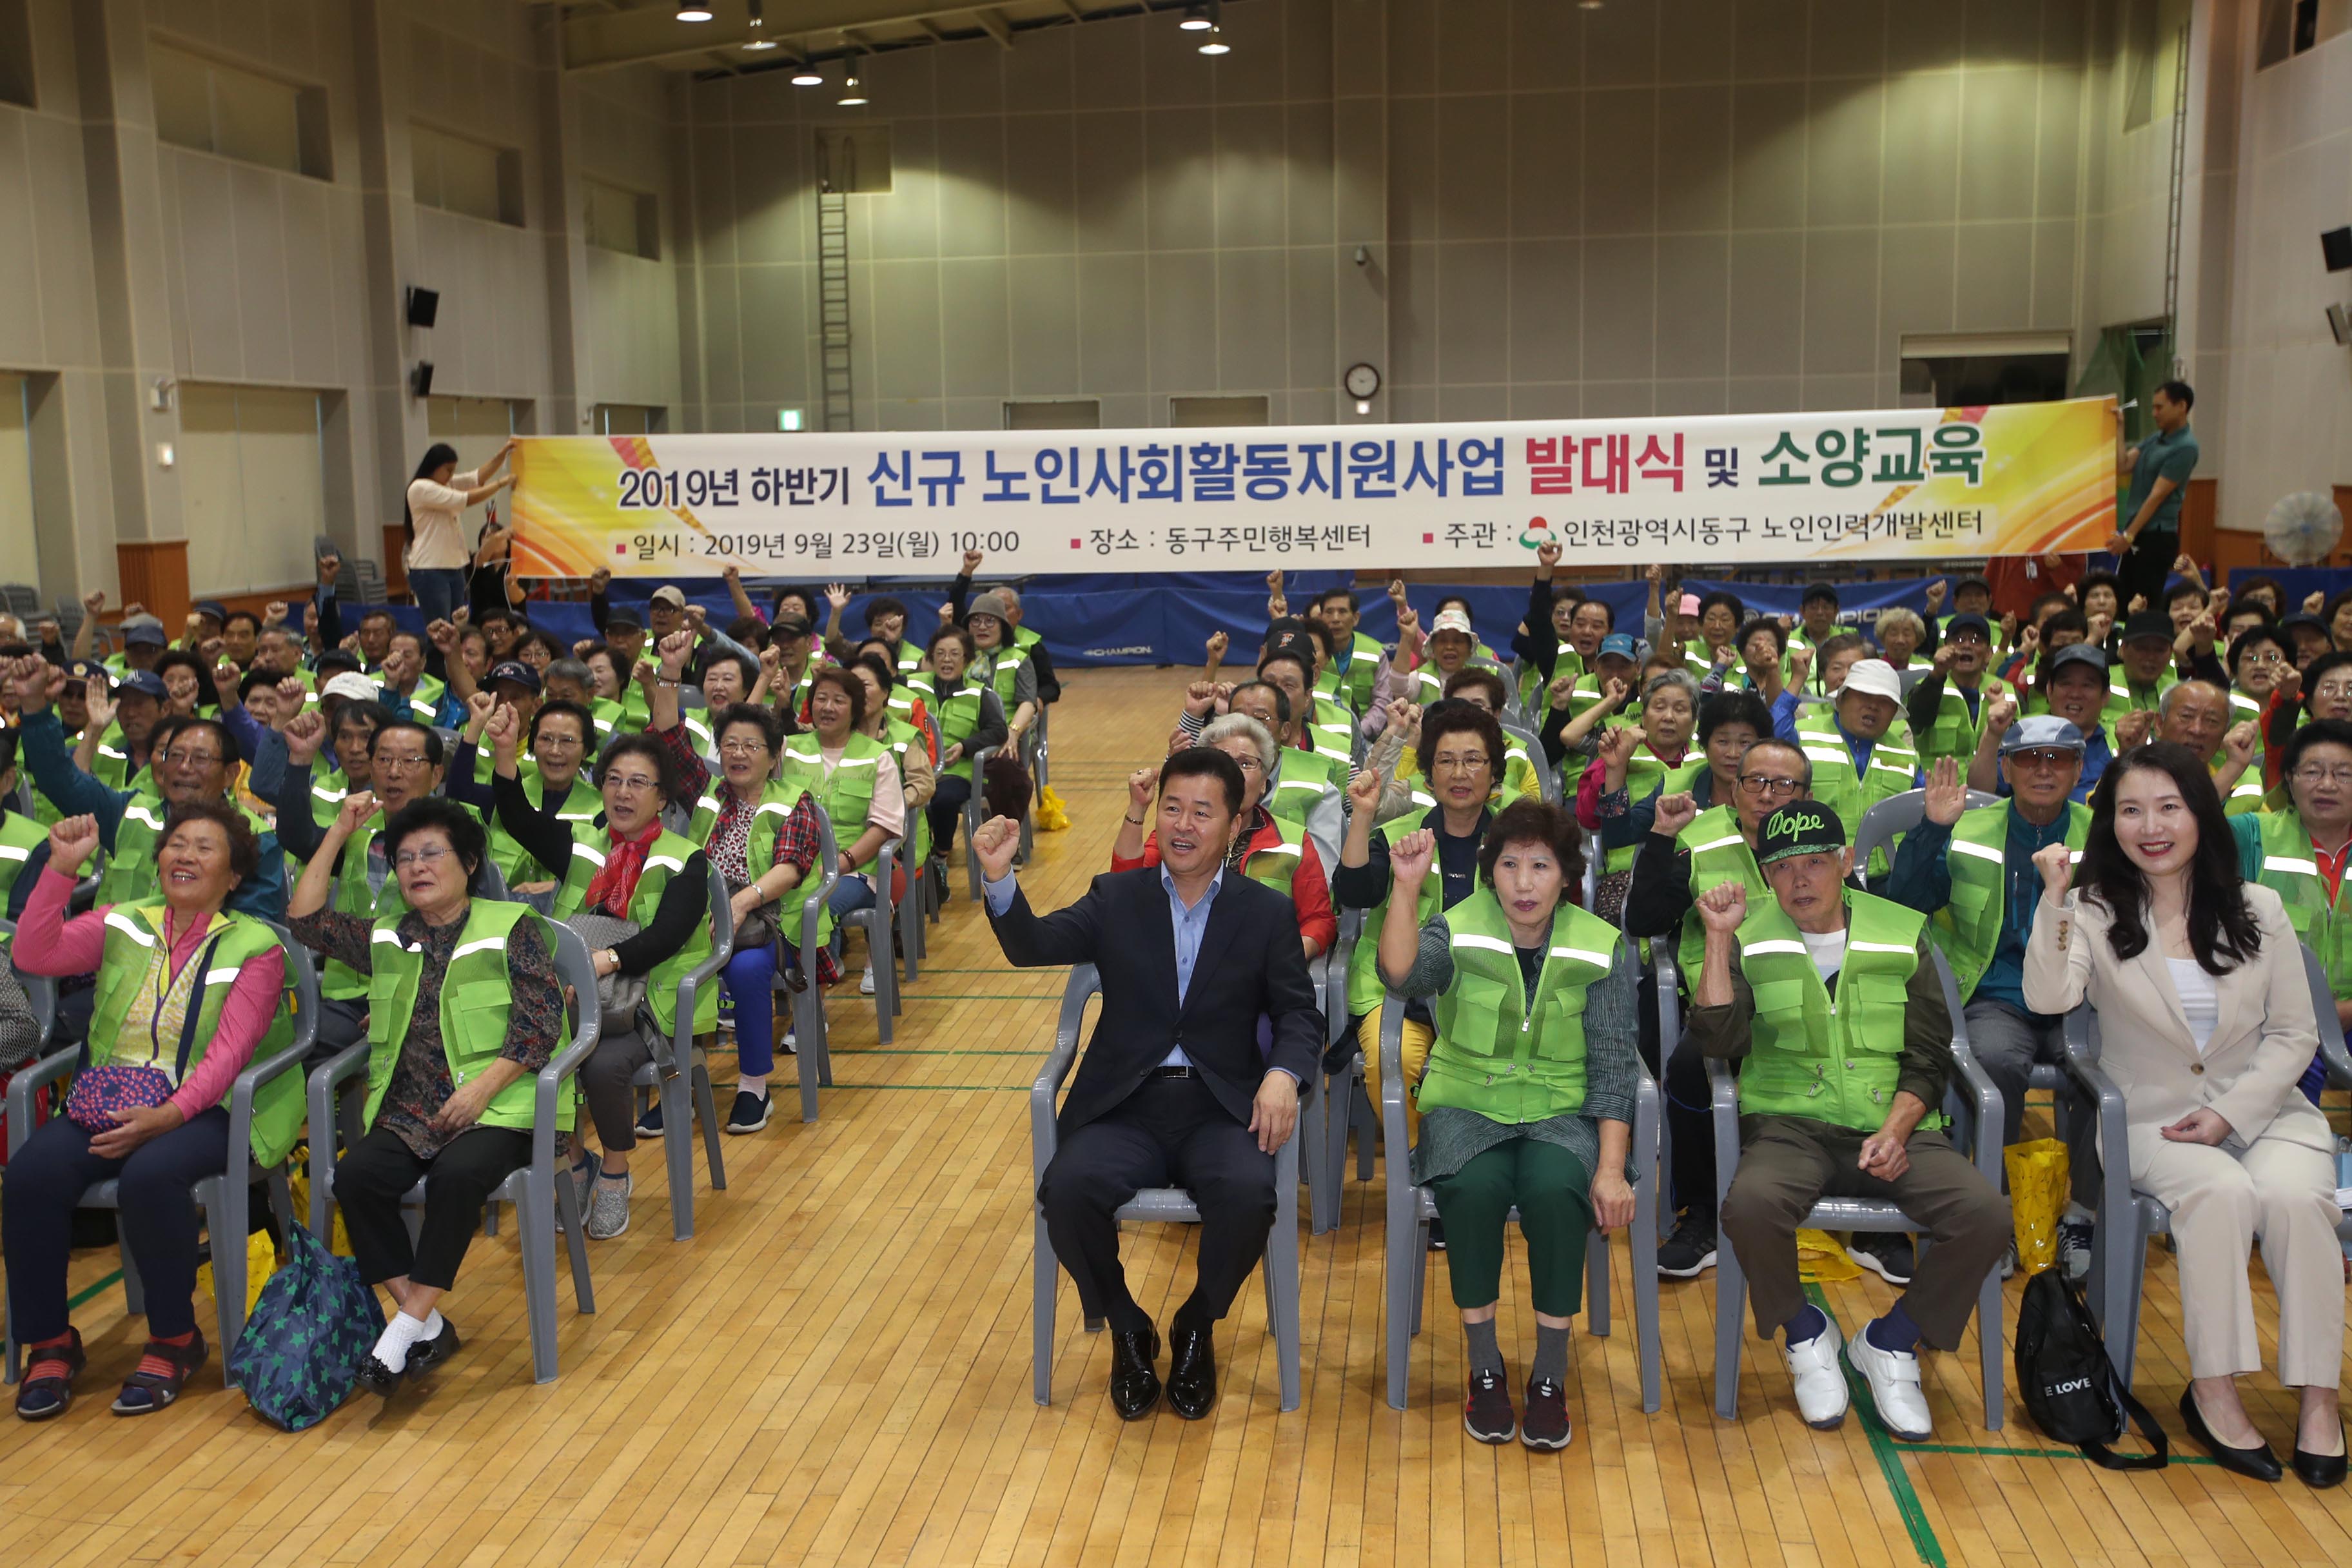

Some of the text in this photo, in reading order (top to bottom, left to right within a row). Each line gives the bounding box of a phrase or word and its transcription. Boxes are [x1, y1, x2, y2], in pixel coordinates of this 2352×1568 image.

[618, 424, 1981, 508] 2019년 하반기 신규 노인사회활동지원사업 발대식 및 소양교육
[1090, 528, 1139, 553] 장소
[1165, 524, 1370, 554] 동구주민행복센터
[1444, 522, 1496, 549] 주관
[1564, 518, 1750, 547] 인천광역시동구
[1761, 509, 1982, 540] 노인인력개발센터
[633, 533, 679, 559] 일시
[703, 532, 785, 557] 2019년
[794, 533, 832, 558] 9월
[842, 531, 939, 558] 23일(월)
[952, 531, 1019, 553] 10:00
[1093, 645, 1152, 656] CHAMPION
[1767, 809, 1825, 843] Dope
[2055, 1377, 2091, 1395] LOVE
